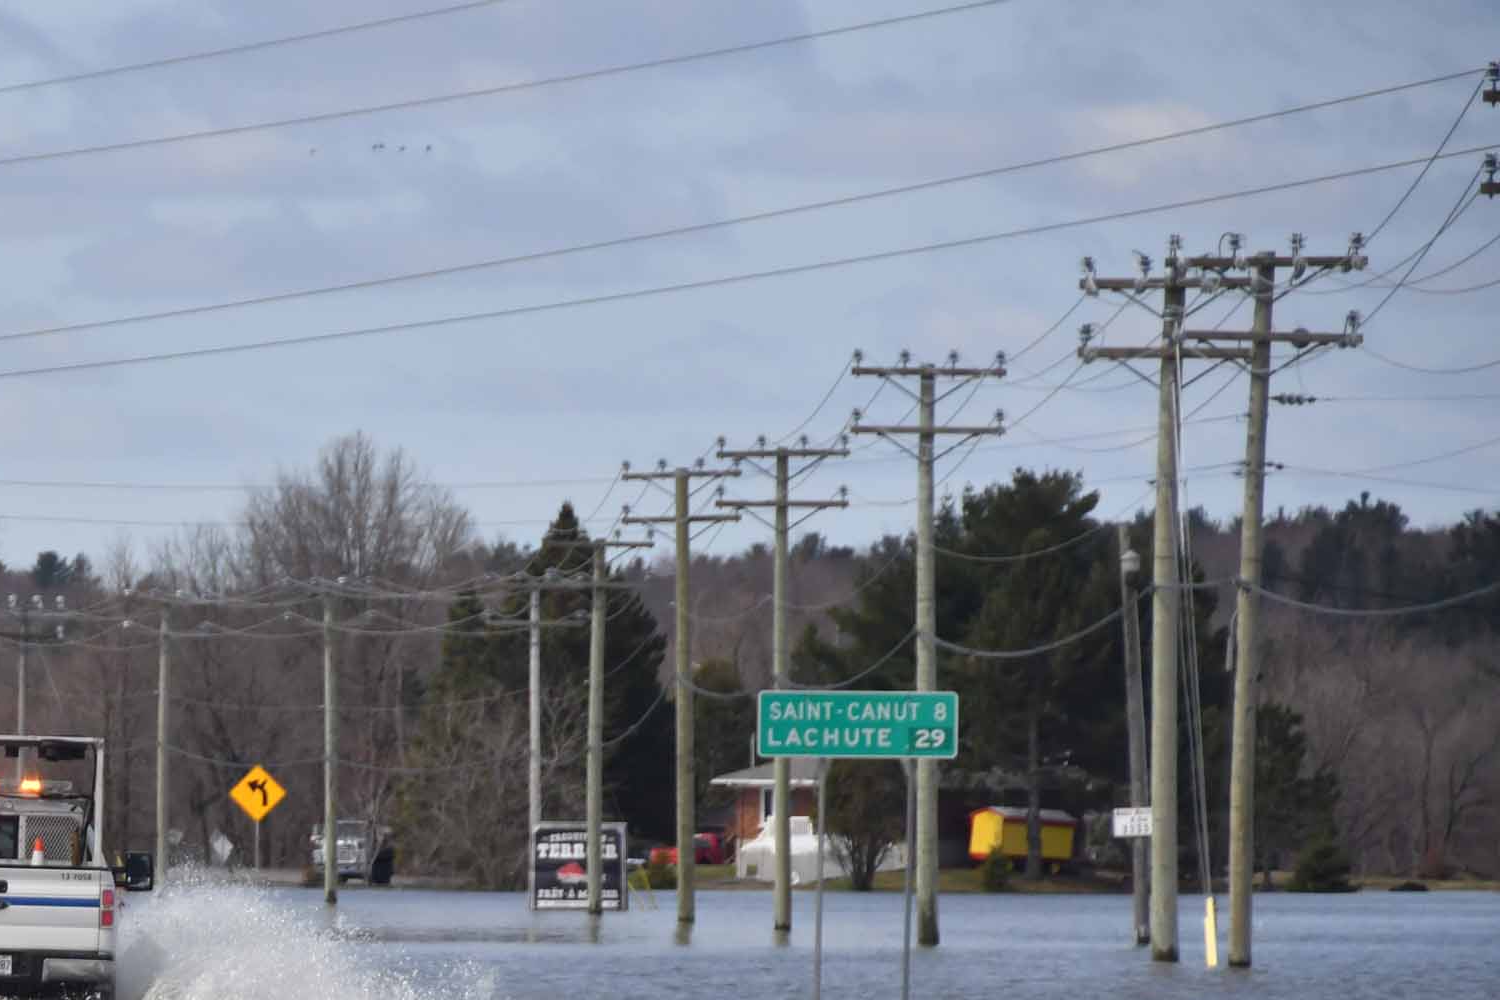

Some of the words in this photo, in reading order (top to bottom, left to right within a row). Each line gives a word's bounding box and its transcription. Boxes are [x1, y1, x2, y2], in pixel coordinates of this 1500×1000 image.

[770, 702, 920, 721] SAINT-CANUT
[933, 702, 947, 721] 8
[767, 728, 892, 748] LACHUTE
[914, 729, 946, 749] 29
